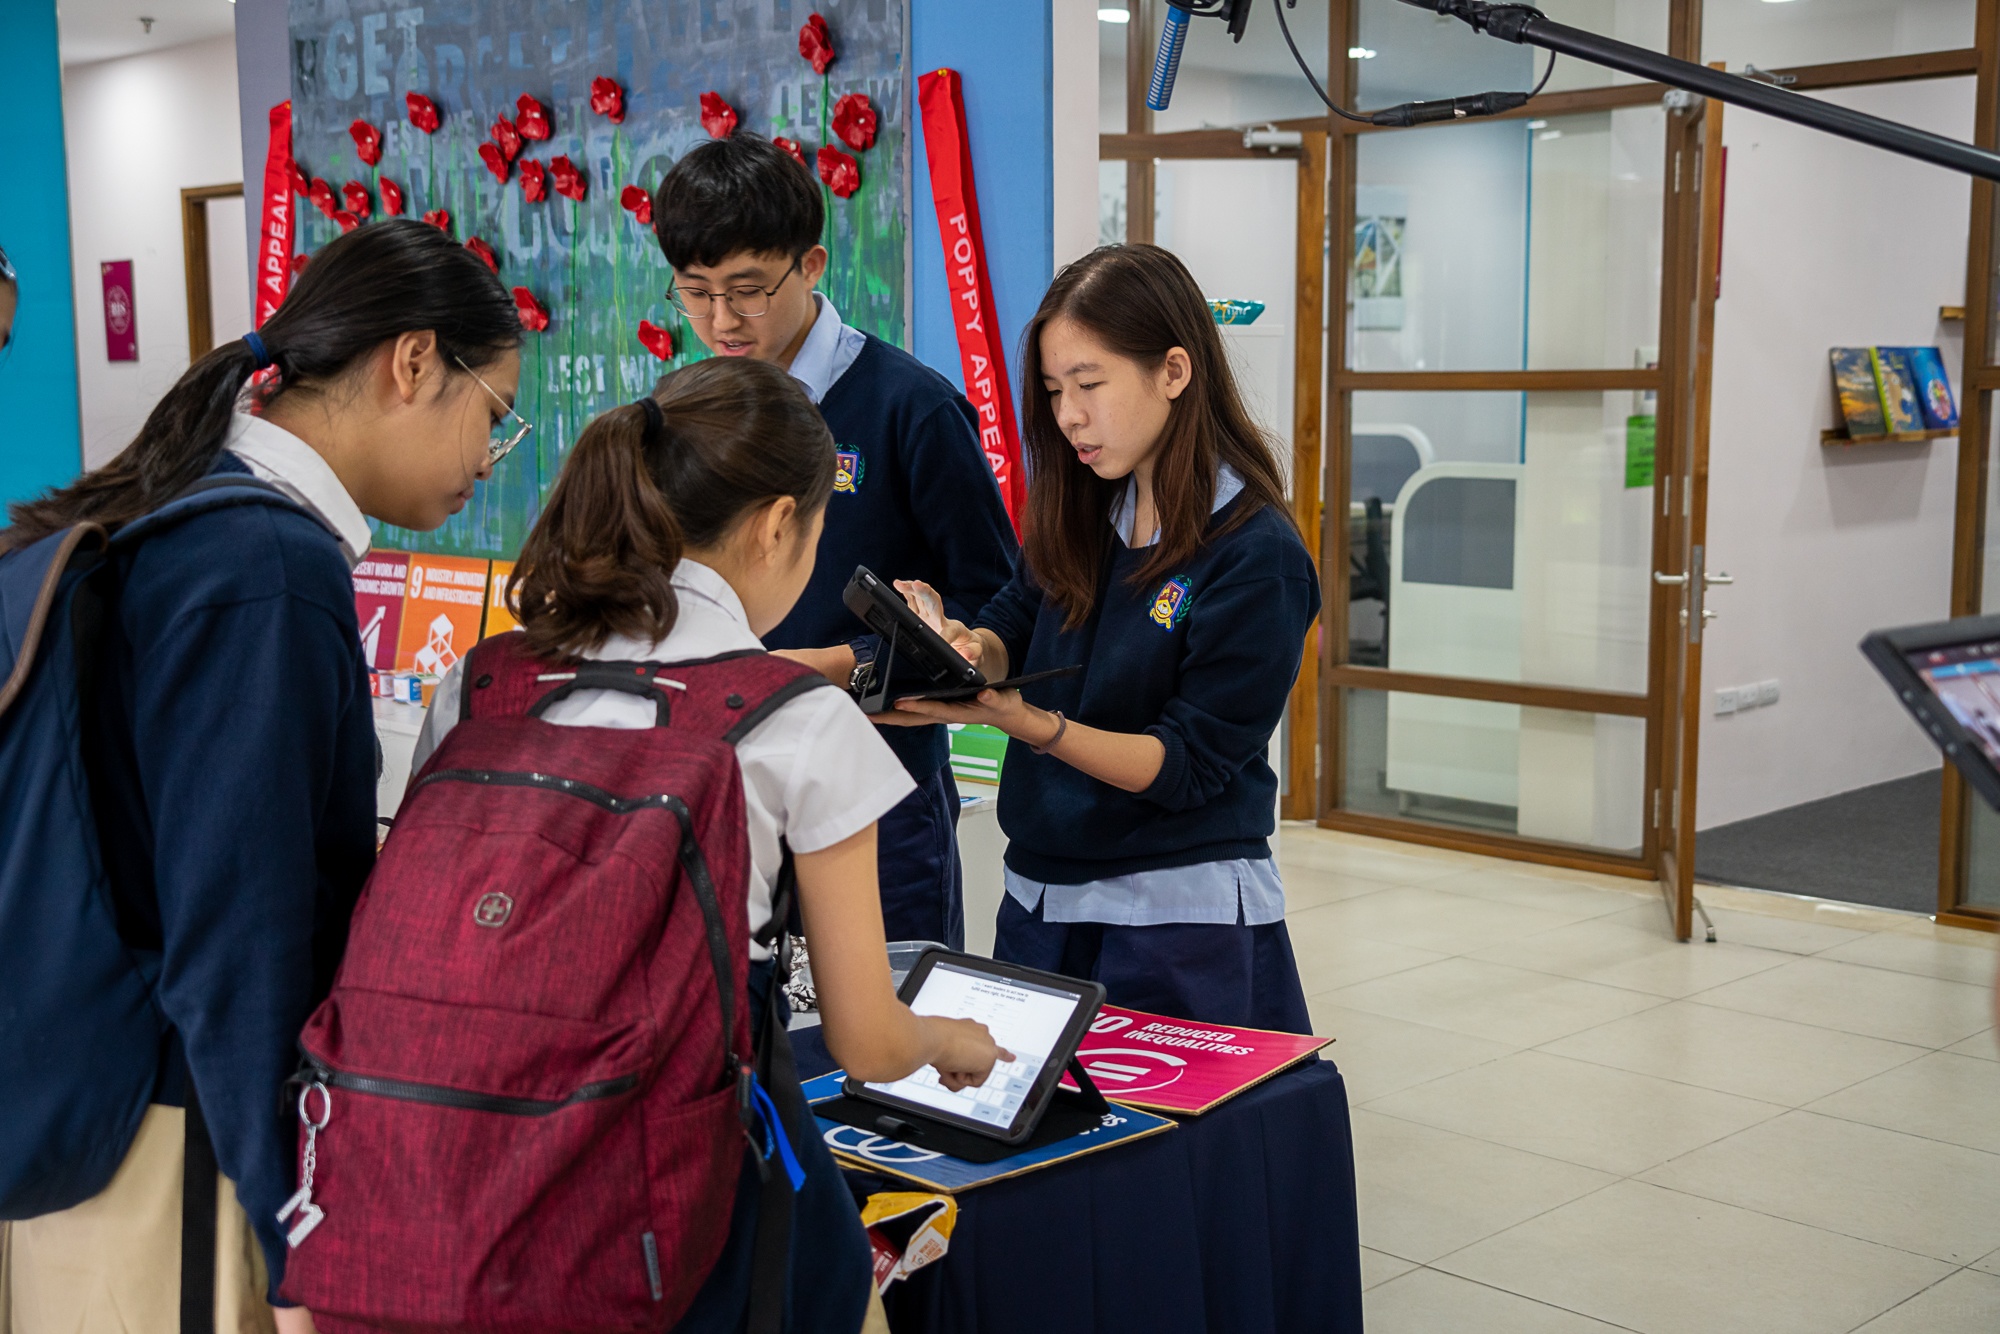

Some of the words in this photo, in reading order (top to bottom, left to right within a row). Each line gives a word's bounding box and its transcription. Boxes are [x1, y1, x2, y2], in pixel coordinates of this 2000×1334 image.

[264, 188, 290, 294] APPEAL
[949, 212, 983, 334] POPPY
[547, 354, 606, 395] LEST
[410, 565, 424, 599] 9
[1088, 1012, 1133, 1033] 0
[1142, 1022, 1236, 1042] REDUCED
[1123, 1029, 1255, 1055] INEQUALITIES
